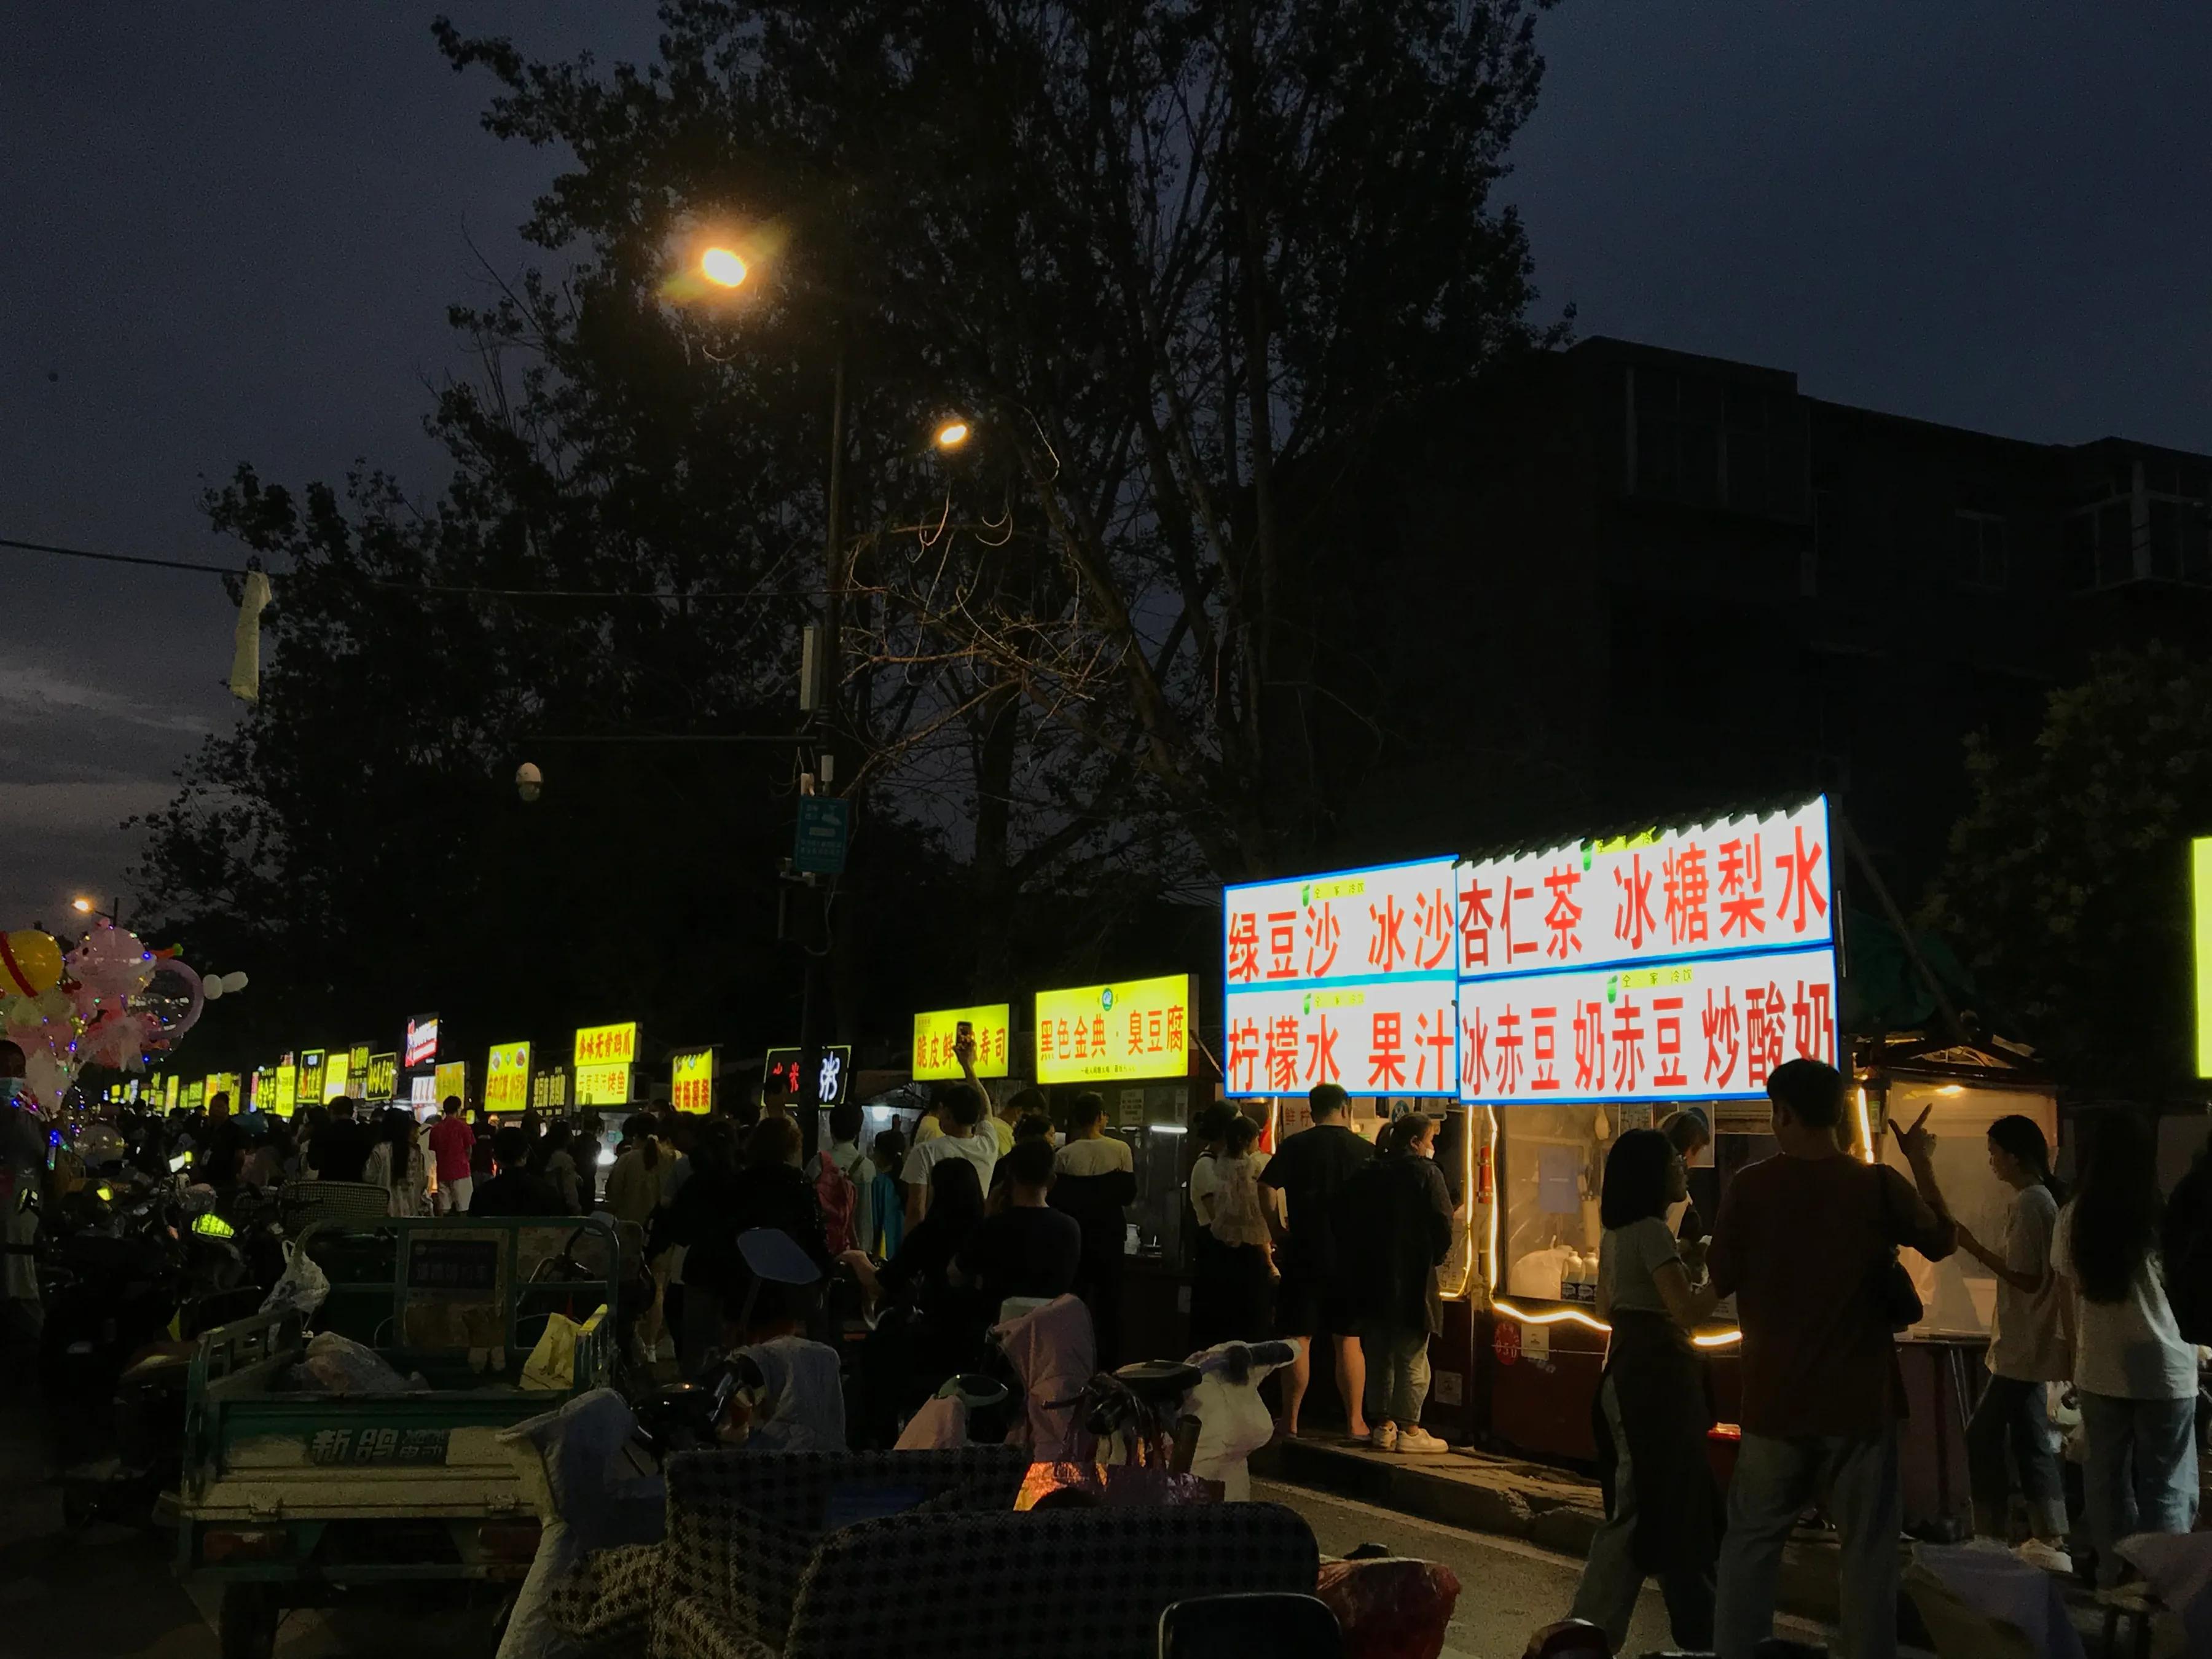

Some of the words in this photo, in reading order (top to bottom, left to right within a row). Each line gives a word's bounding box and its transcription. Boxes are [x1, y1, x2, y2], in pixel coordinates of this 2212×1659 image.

[1228, 901, 1341, 982] 绿豆沙
[1368, 888, 1454, 973] 冰沙
[1459, 864, 1583, 967] 杏仁茶
[1614, 825, 1827, 950] 冰糖梨水
[916, 1026, 1006, 1070] 脆皮鲜寿司
[1228, 1013, 1341, 1091] 柠檬水
[1368, 1008, 1454, 1091] 果汁
[1462, 1004, 1560, 1095] 冰赤豆
[1572, 994, 1688, 1091] 奶赤豆
[1701, 980, 1834, 1088] 炒酸奶
